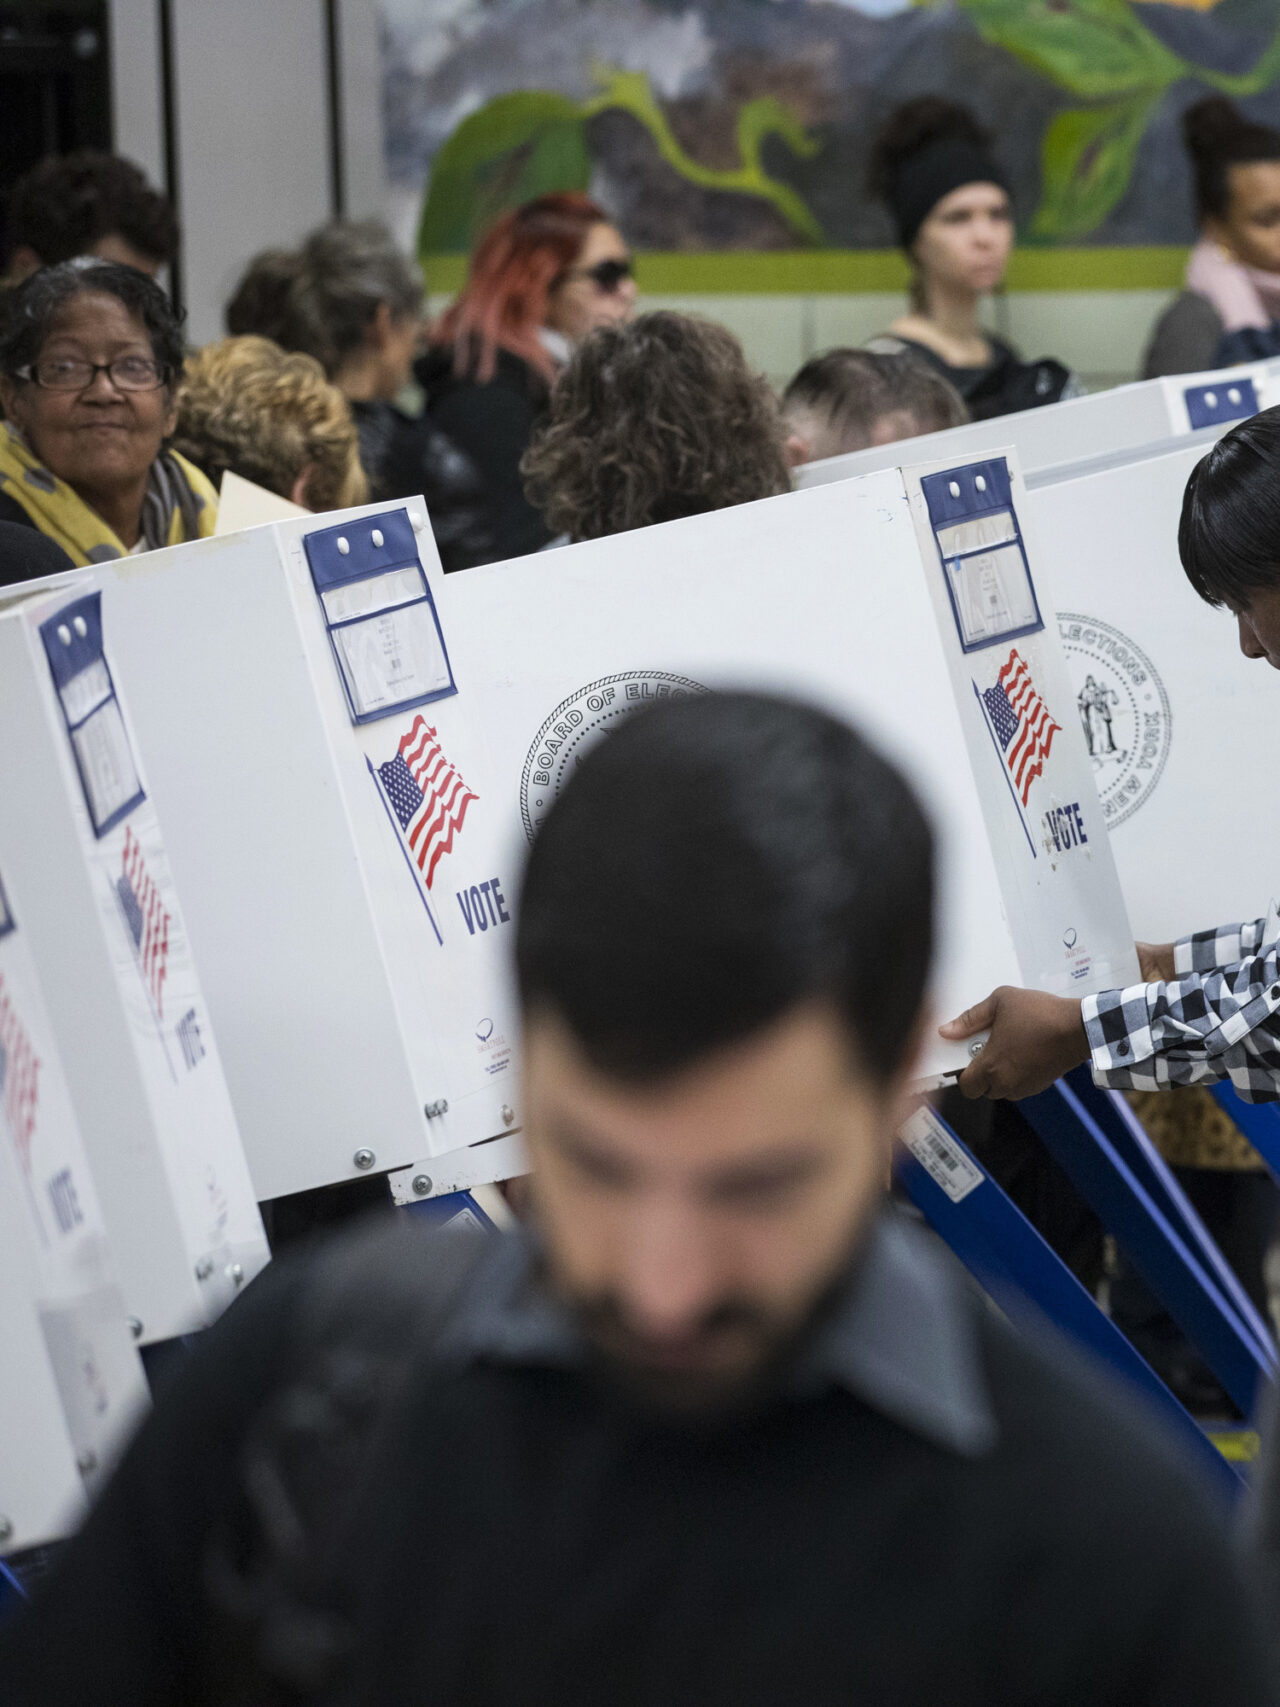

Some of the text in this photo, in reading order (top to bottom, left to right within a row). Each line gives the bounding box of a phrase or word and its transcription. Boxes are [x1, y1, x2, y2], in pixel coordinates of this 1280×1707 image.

[1058, 623, 1148, 687] LECTIONS
[532, 682, 690, 786] BOARD OF ELEC
[1136, 711, 1160, 770] YORK
[1045, 802, 1088, 852] VOTE
[456, 877, 511, 935] VOTE
